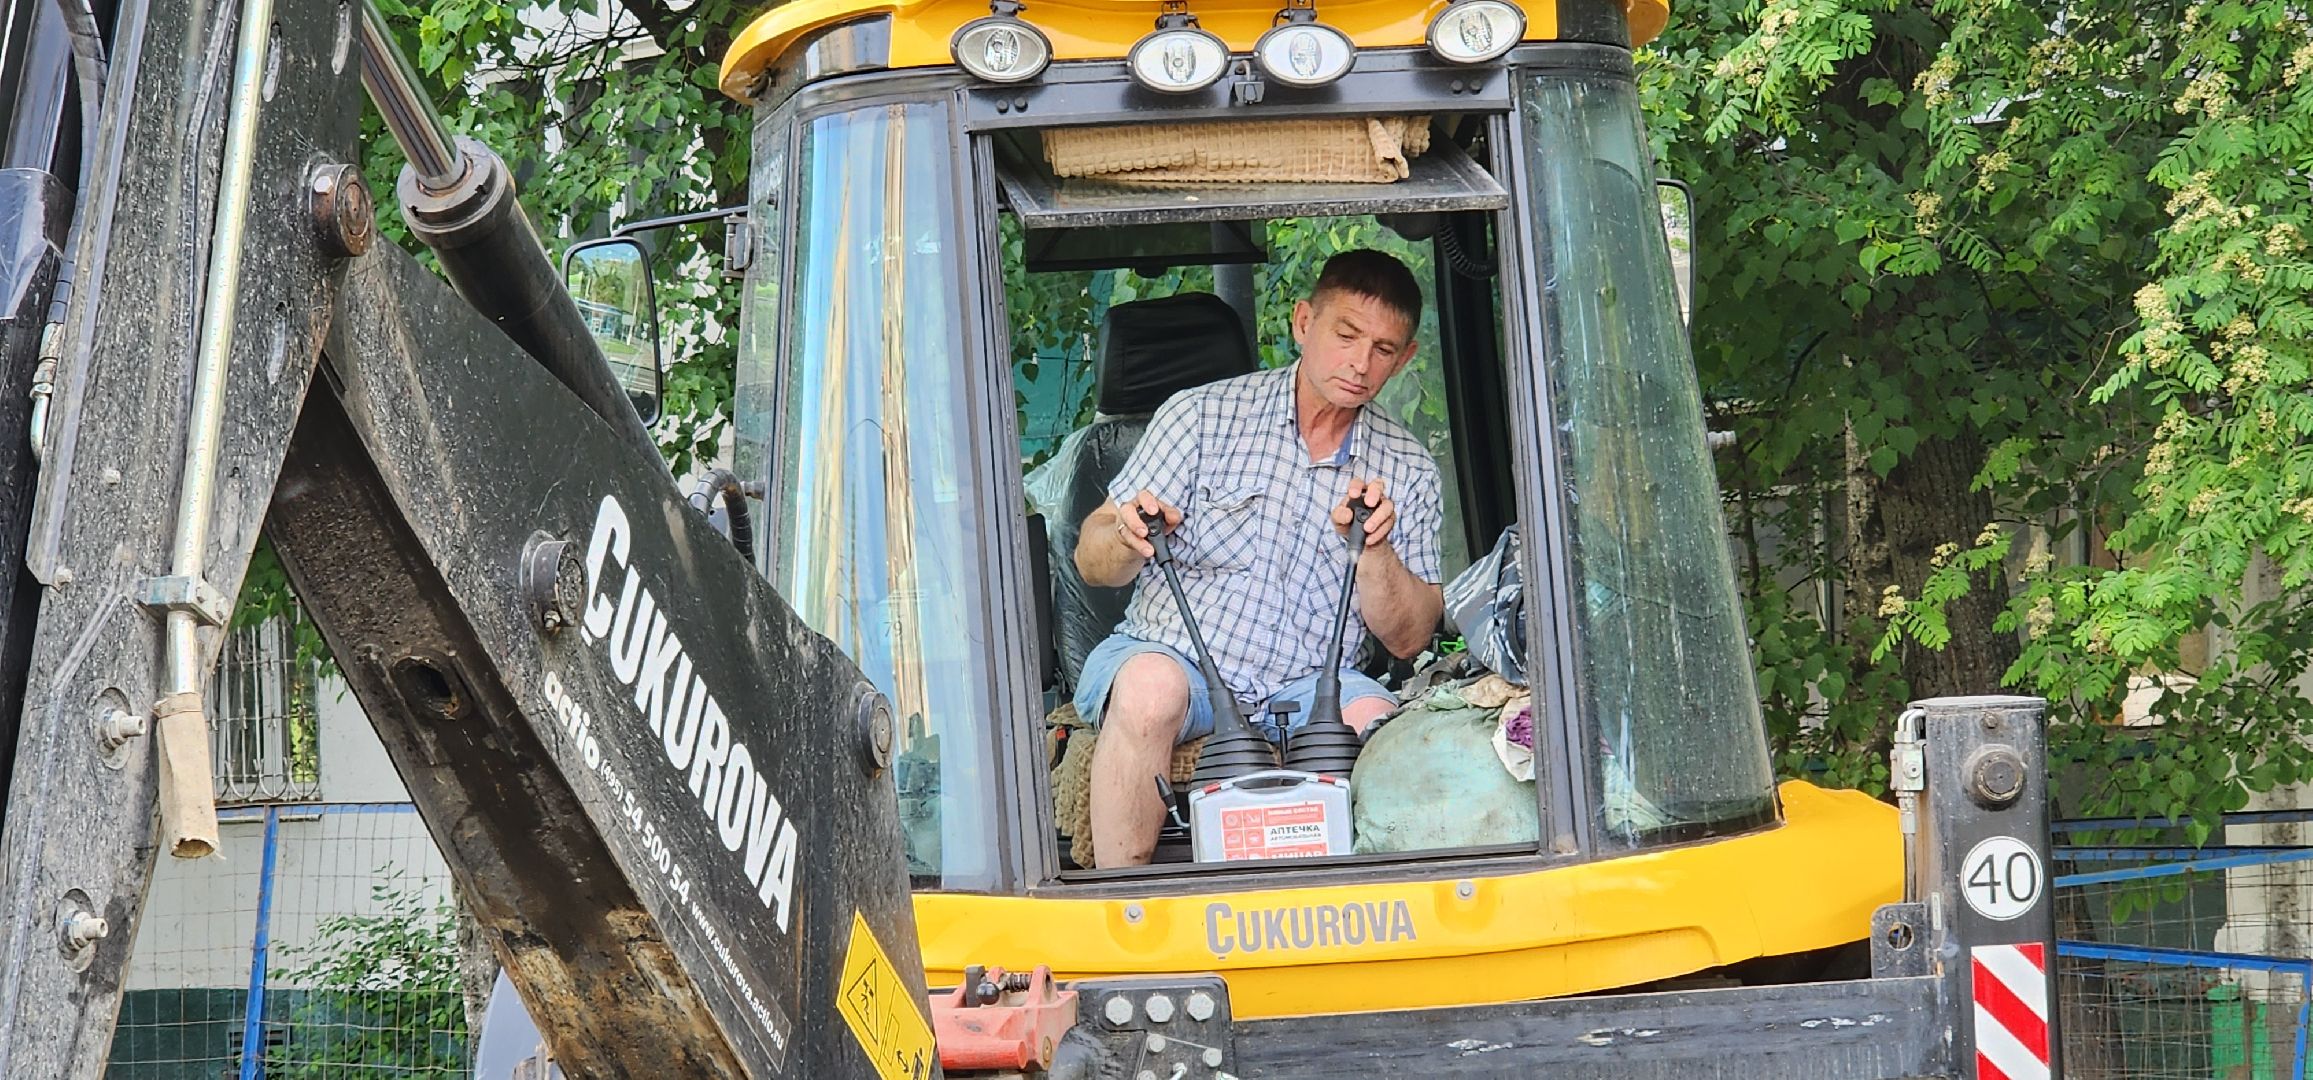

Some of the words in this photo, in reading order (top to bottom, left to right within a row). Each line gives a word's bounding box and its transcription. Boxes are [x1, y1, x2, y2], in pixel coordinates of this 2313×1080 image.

[580, 495, 797, 935] ÇUKUROVA
[1270, 824, 1321, 835] АПТЕЧКА
[545, 671, 600, 770] actio
[601, 759, 623, 802] (495)
[623, 791, 643, 832] 54
[642, 821, 671, 874] 500
[669, 863, 690, 905] 54
[691, 901, 784, 1050] www.cukurova.actio.ru
[1967, 851, 2037, 904] 40
[1205, 900, 1417, 960] ÇUKUROVA
